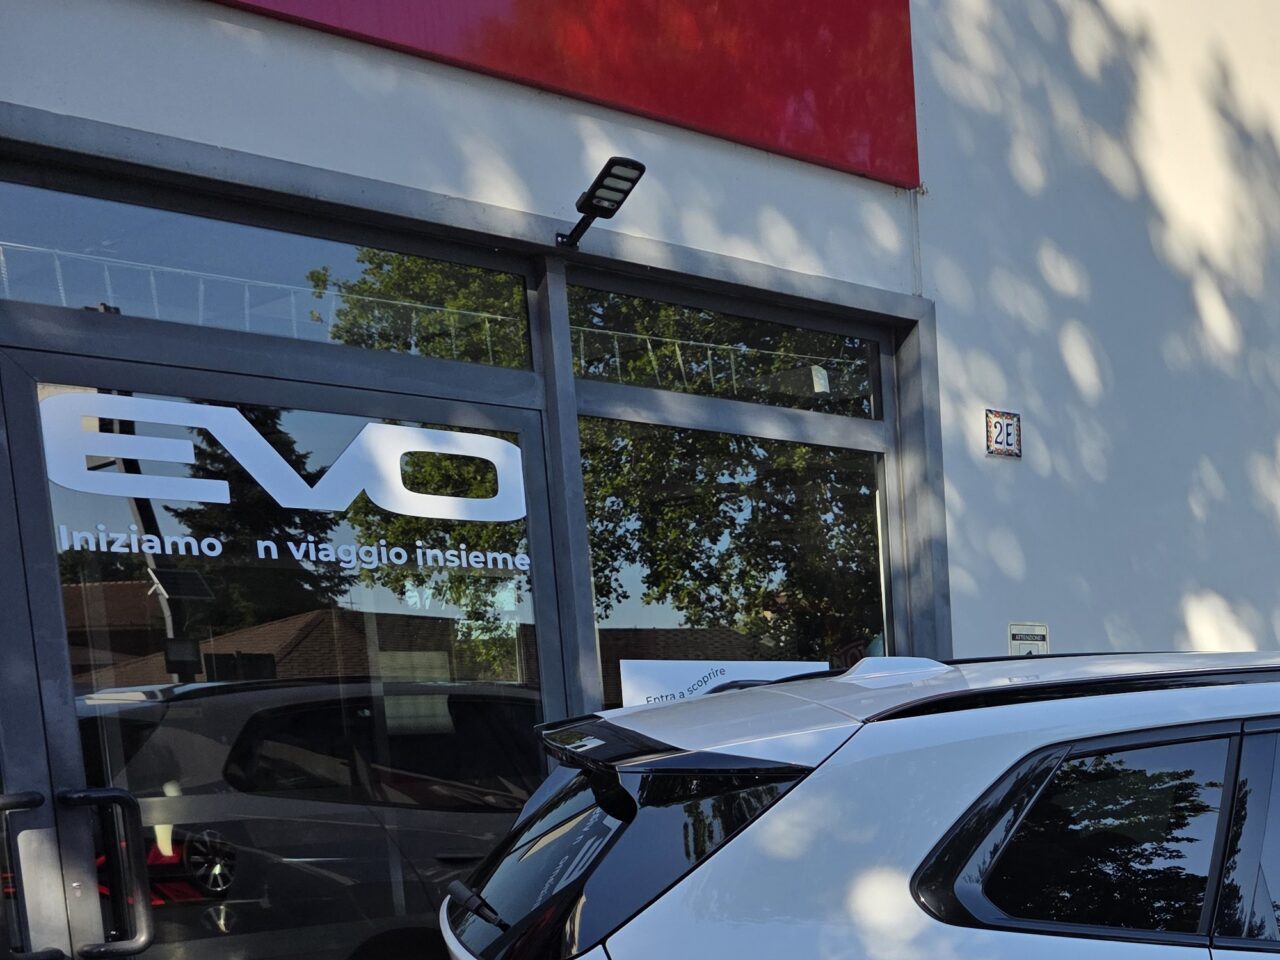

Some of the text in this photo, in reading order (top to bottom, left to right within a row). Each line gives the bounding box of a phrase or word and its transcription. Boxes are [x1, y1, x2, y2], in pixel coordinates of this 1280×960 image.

[993, 420, 1014, 447] 2E
[38, 392, 527, 522] EVO
[57, 523, 223, 558] Iniziamo
[287, 535, 408, 570] viaggio
[415, 539, 531, 571] insieme
[645, 667, 726, 704] Entra a scoprire
